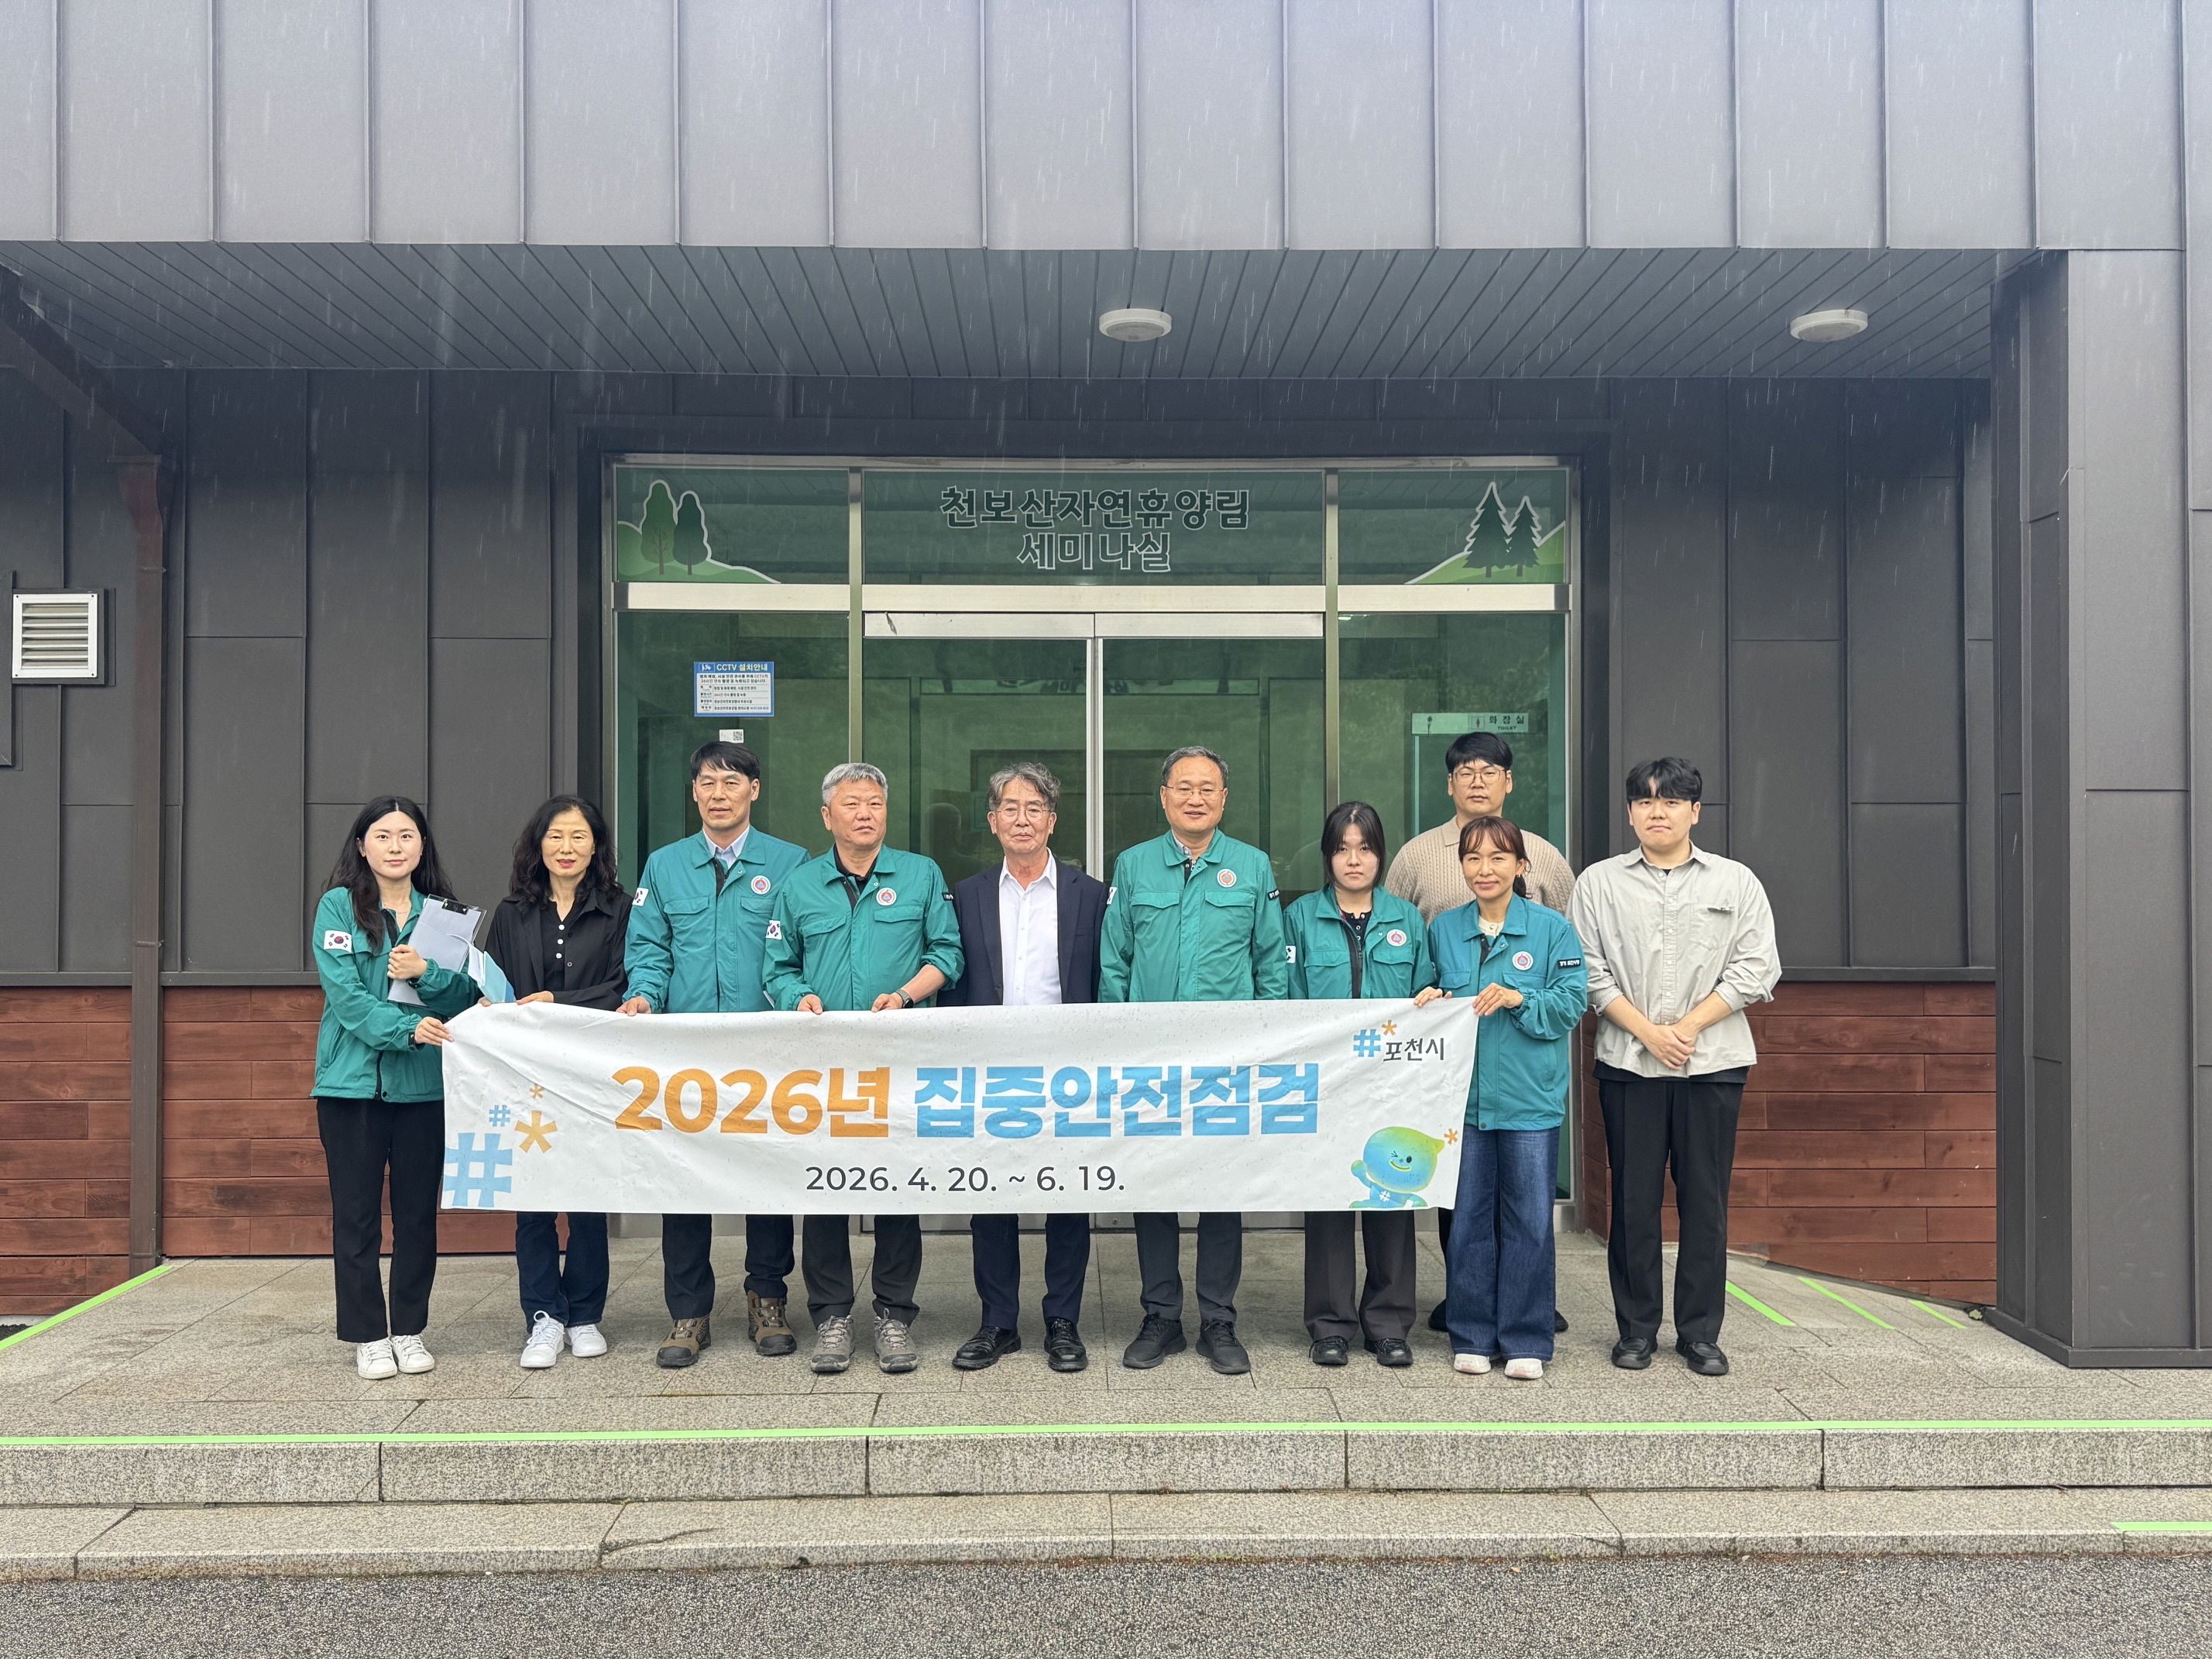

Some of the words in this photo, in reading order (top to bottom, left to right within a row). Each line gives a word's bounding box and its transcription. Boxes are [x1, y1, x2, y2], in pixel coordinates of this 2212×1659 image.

[940, 485, 1249, 531] 천보산자연휴양림
[1016, 531, 1171, 573] 세미나실
[739, 663, 768, 672] 설치안내
[1489, 716, 1524, 724] 화장실
[1382, 1038, 1446, 1063] 포천시
[611, 1065, 891, 1139] 2026년
[914, 1063, 1319, 1139] 집중안전점검
[805, 1166, 898, 1193] 2026.
[907, 1167, 937, 1193] 4.
[947, 1166, 998, 1193] 20.
[1036, 1165, 1066, 1193] 6.
[1079, 1165, 1125, 1193] 19.
